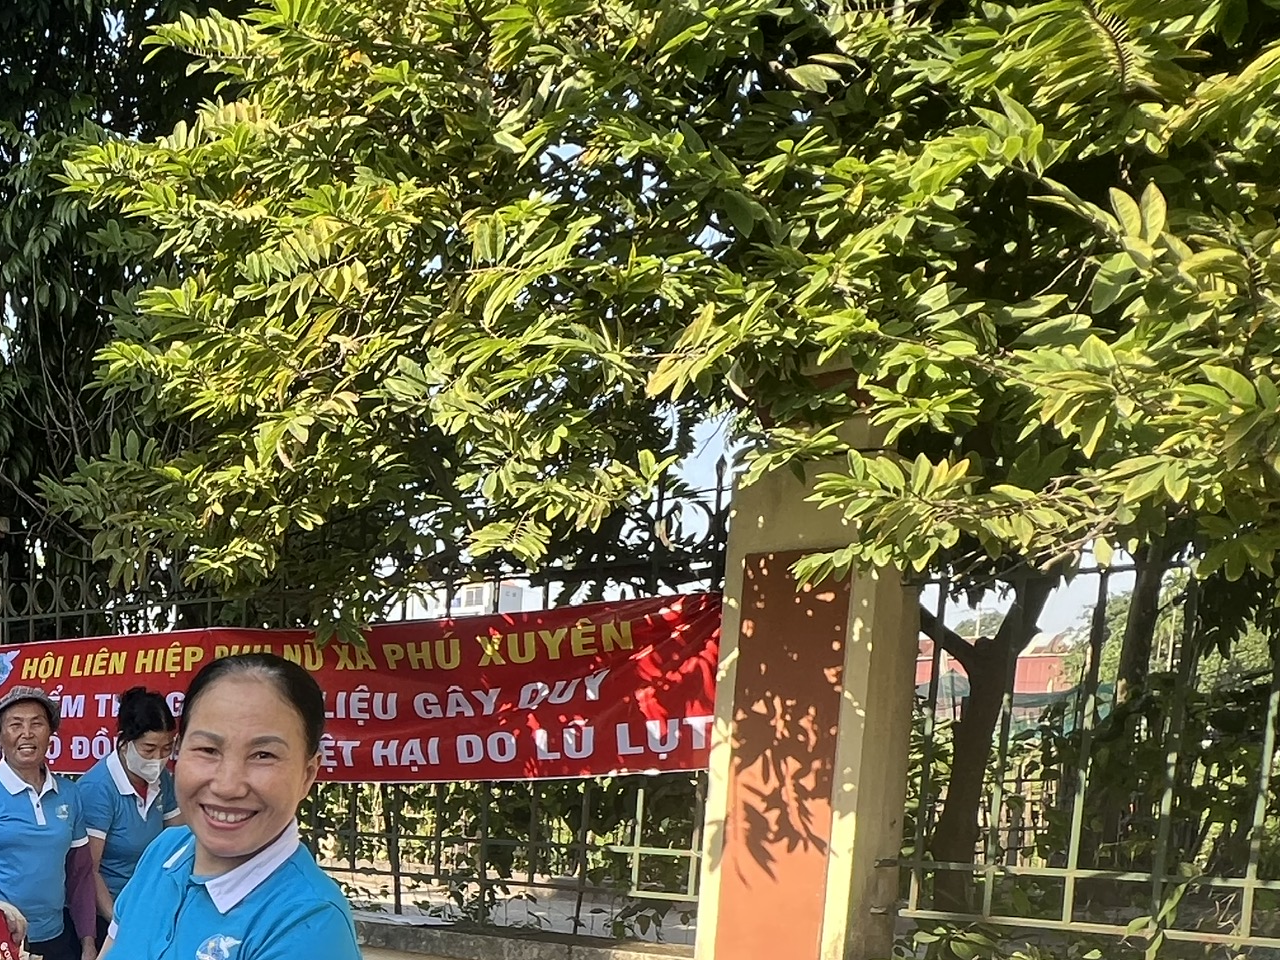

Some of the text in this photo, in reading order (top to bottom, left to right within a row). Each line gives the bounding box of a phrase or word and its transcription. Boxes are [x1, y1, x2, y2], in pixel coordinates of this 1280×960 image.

[21, 651, 64, 683] HỘI
[69, 647, 127, 678] LIÊN
[134, 641, 204, 678] HIỆP
[382, 632, 461, 670] PHÚ
[476, 617, 634, 667] XUYÊN
[413, 684, 501, 720] GÂY
[372, 736, 440, 772] HẠI
[456, 731, 517, 764] DO
[534, 717, 595, 761] LŨ
[616, 715, 715, 760] LỤT
